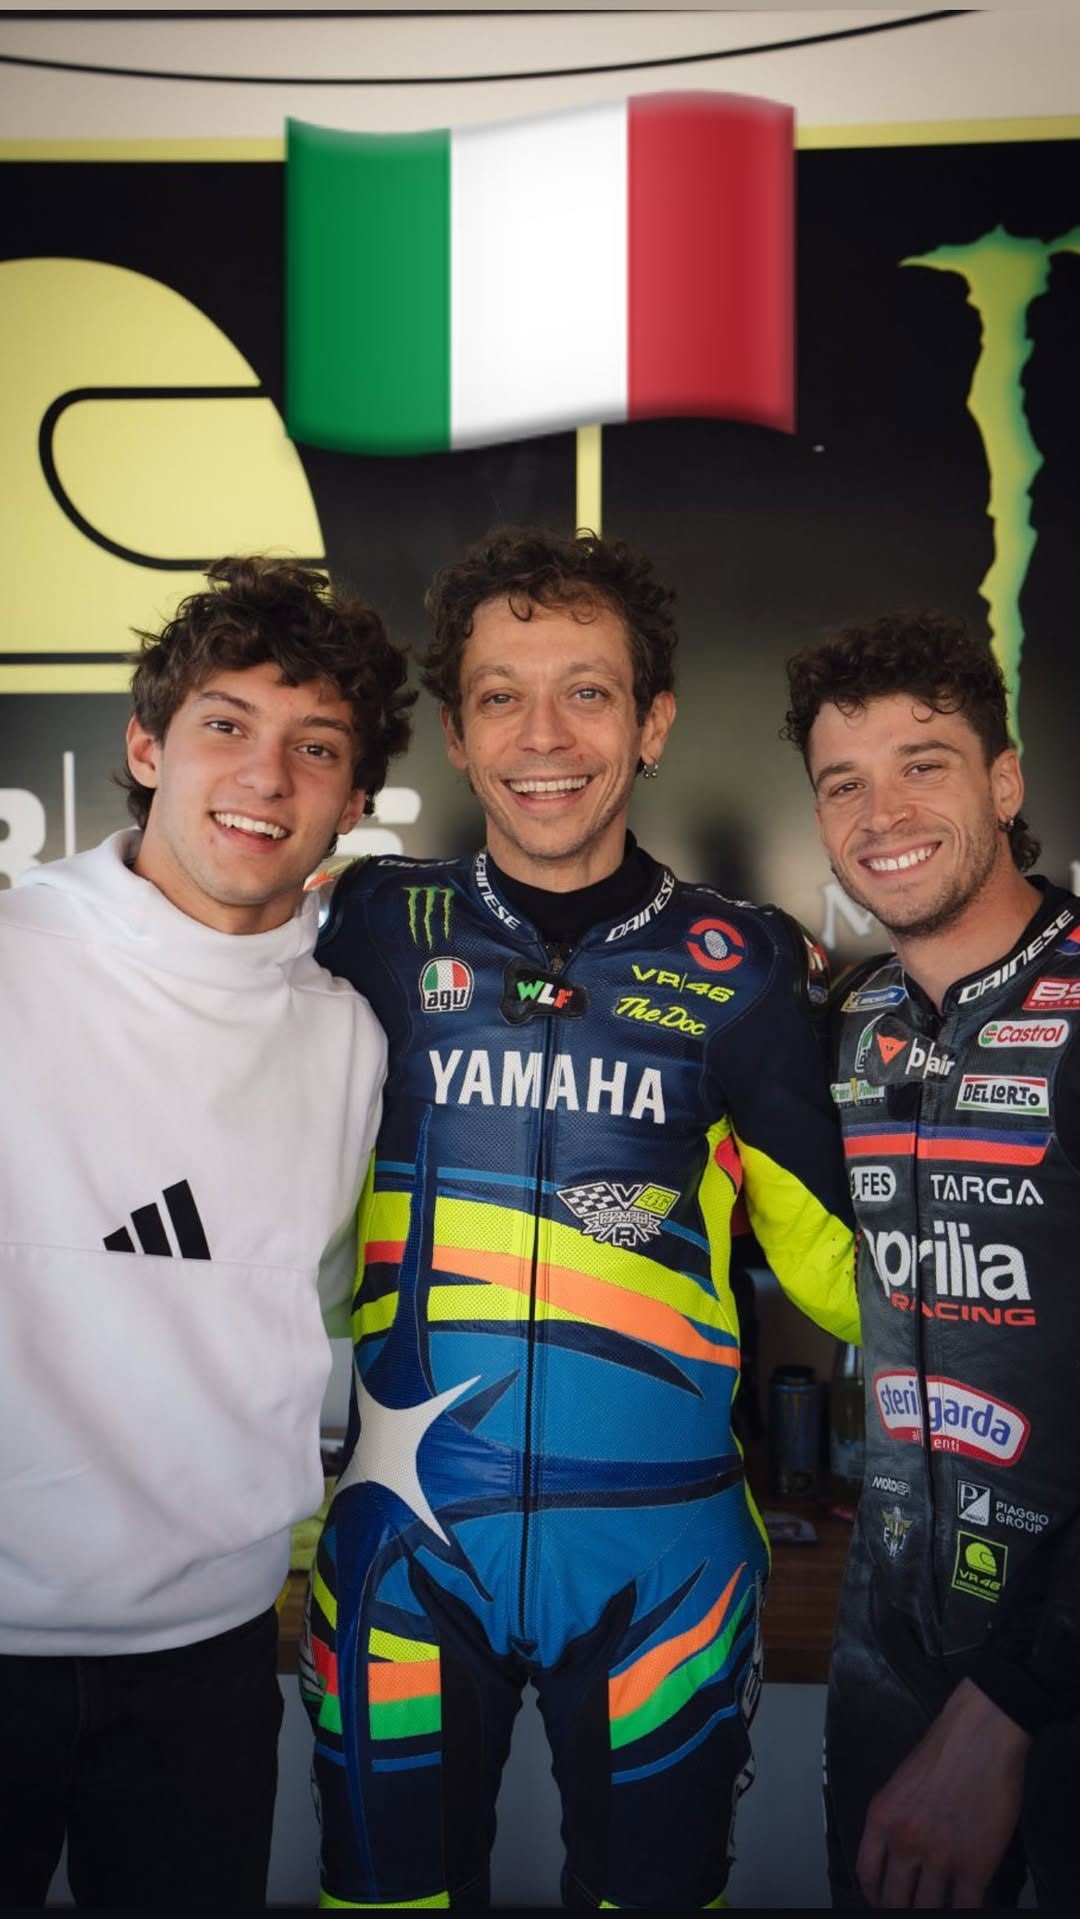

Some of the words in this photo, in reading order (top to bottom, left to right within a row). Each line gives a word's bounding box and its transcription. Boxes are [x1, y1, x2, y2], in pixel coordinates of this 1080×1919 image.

[604, 871, 675, 942] DAINESE
[957, 909, 1074, 1005] DAINESE
[516, 980, 573, 1008] WLF
[996, 1024, 1065, 1043] Castrol
[428, 1049, 667, 1125] YAMAHA
[930, 1174, 1045, 1206] TARGA
[880, 1380, 1012, 1447] sterigarda
[995, 1501, 1049, 1526] PIAGGIO
[995, 1512, 1043, 1535] GROUP
